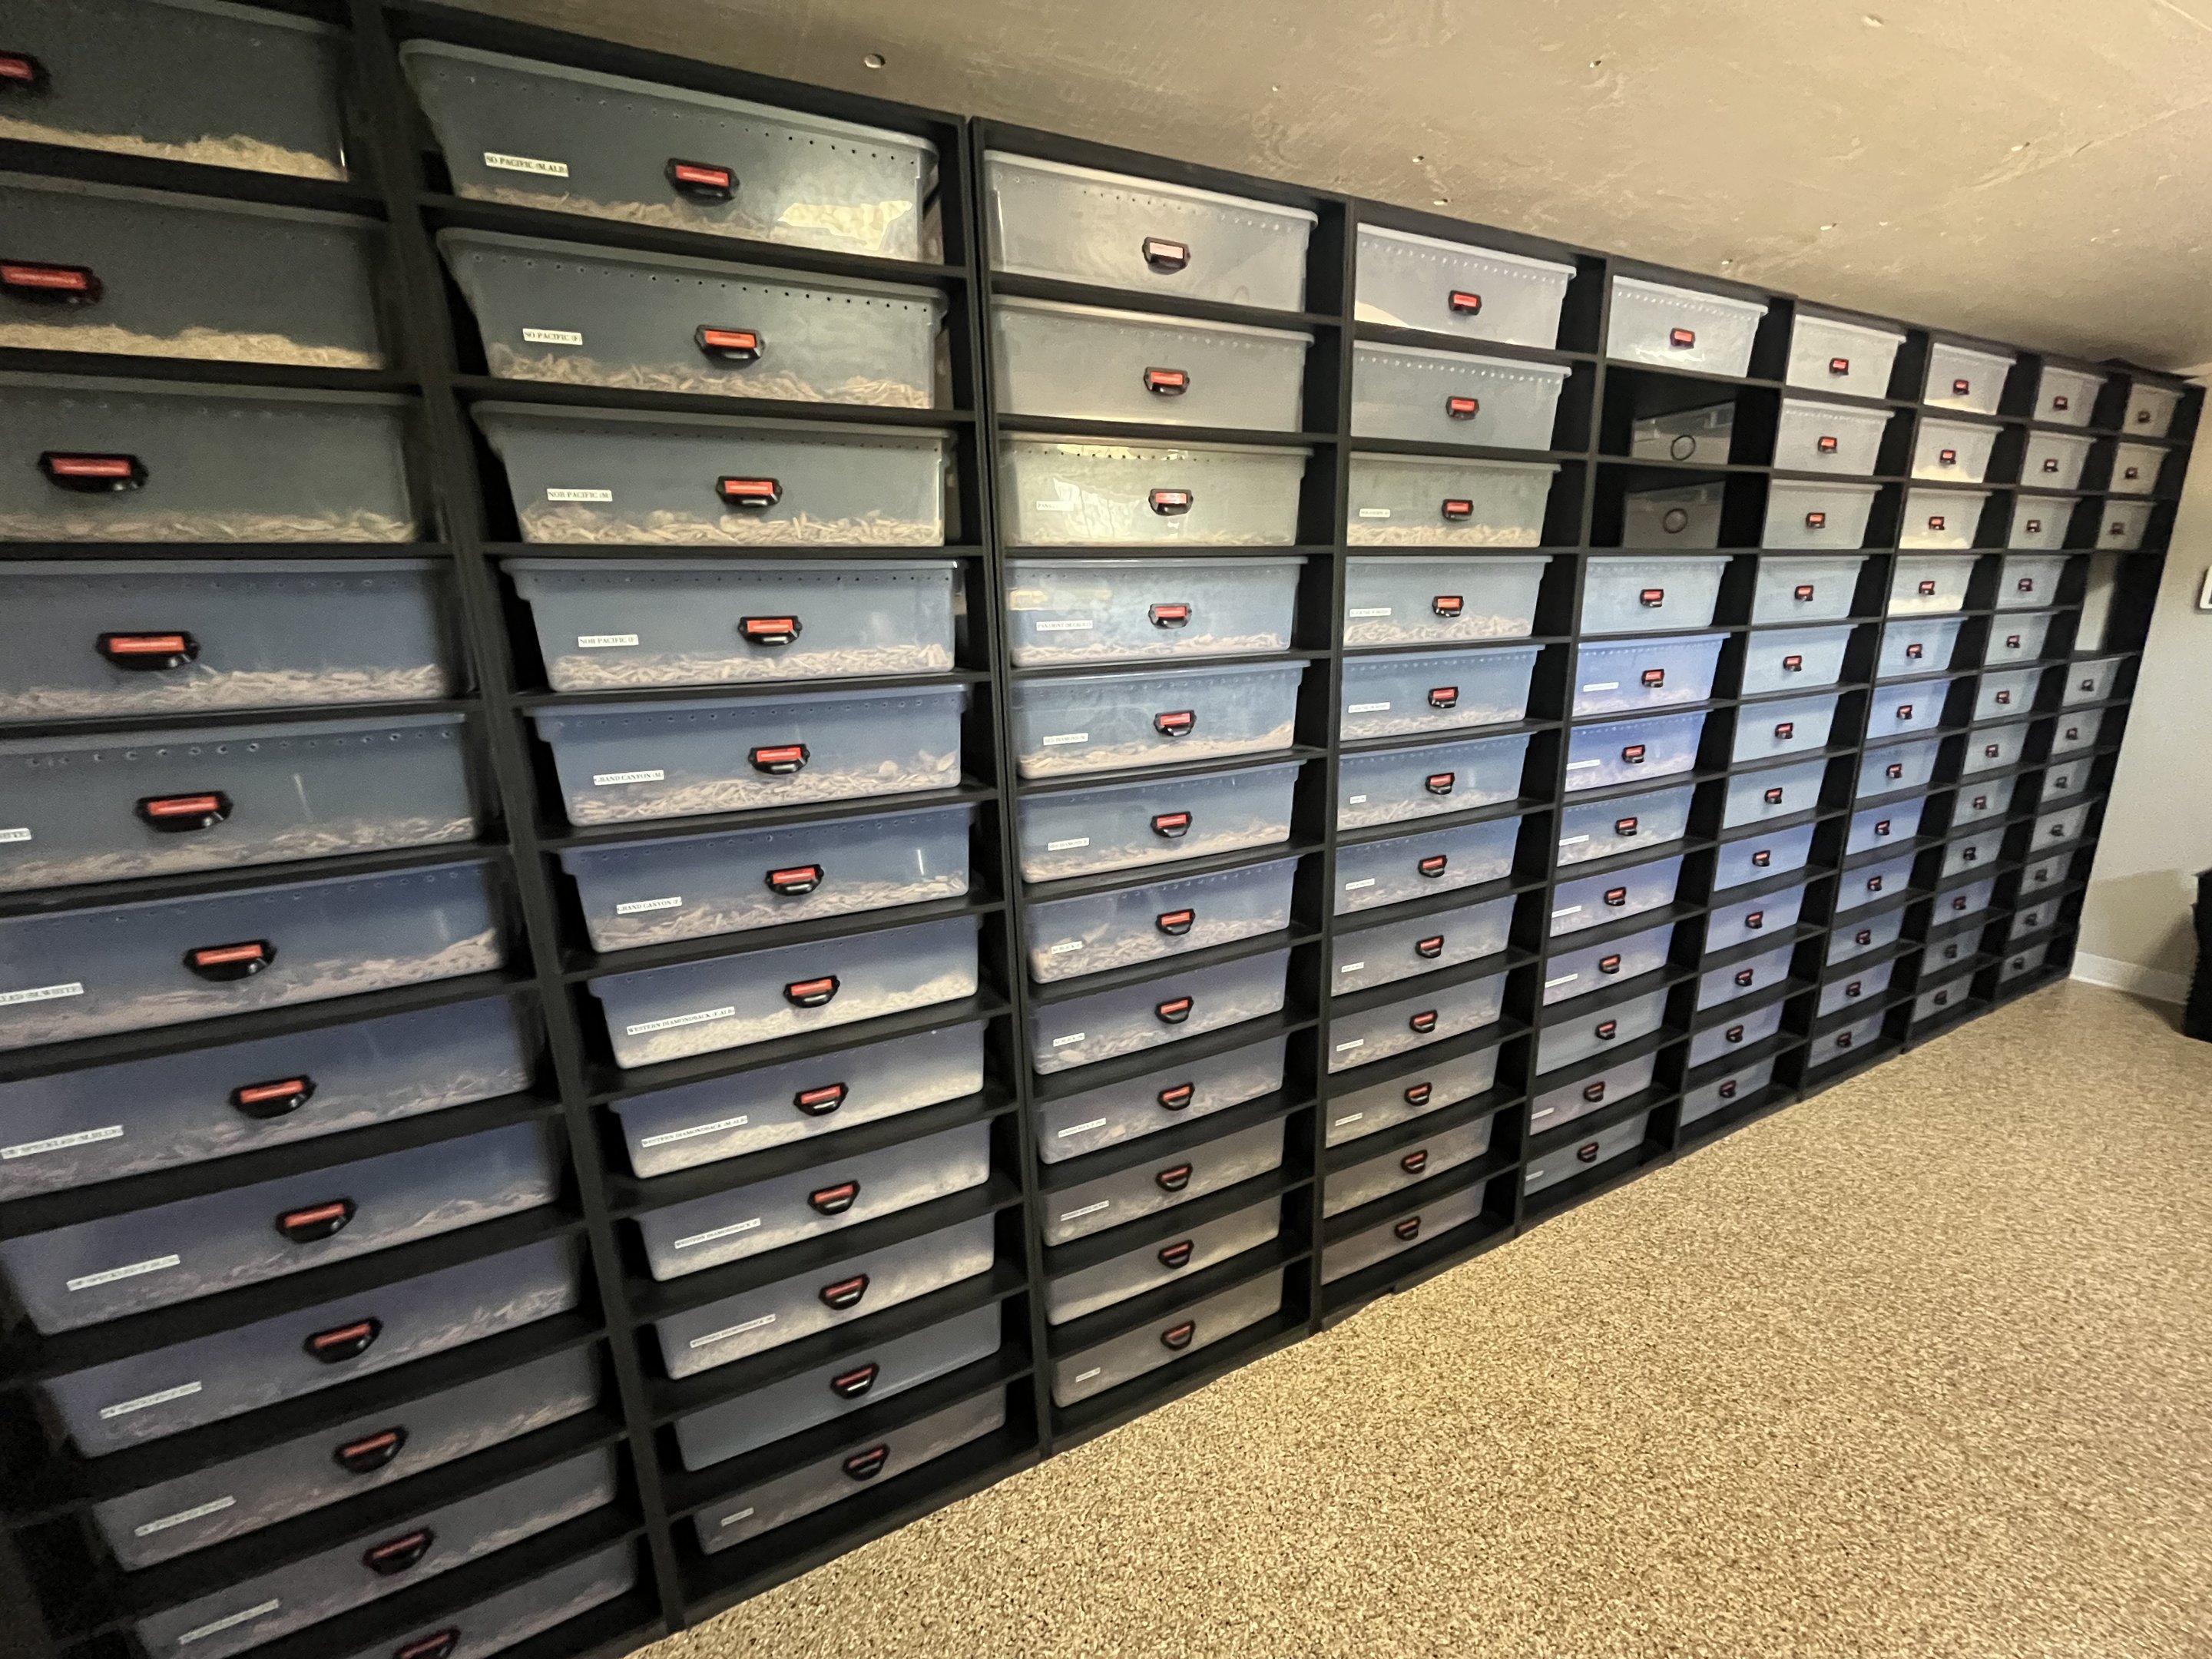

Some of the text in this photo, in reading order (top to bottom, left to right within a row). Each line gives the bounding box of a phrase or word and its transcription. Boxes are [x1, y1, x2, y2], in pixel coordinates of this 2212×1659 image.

[499, 157, 533, 169] PACIFIC
[594, 775, 621, 783] GRAND
[621, 773, 651, 781] CANYON
[643, 899, 672, 909] CANYON
[628, 1022, 661, 1033] WESTERN
[662, 1012, 711, 1027] DIAMONDBACK
[642, 1134, 674, 1145] WESTERN
[675, 1123, 722, 1138] DIAMONDBACK
